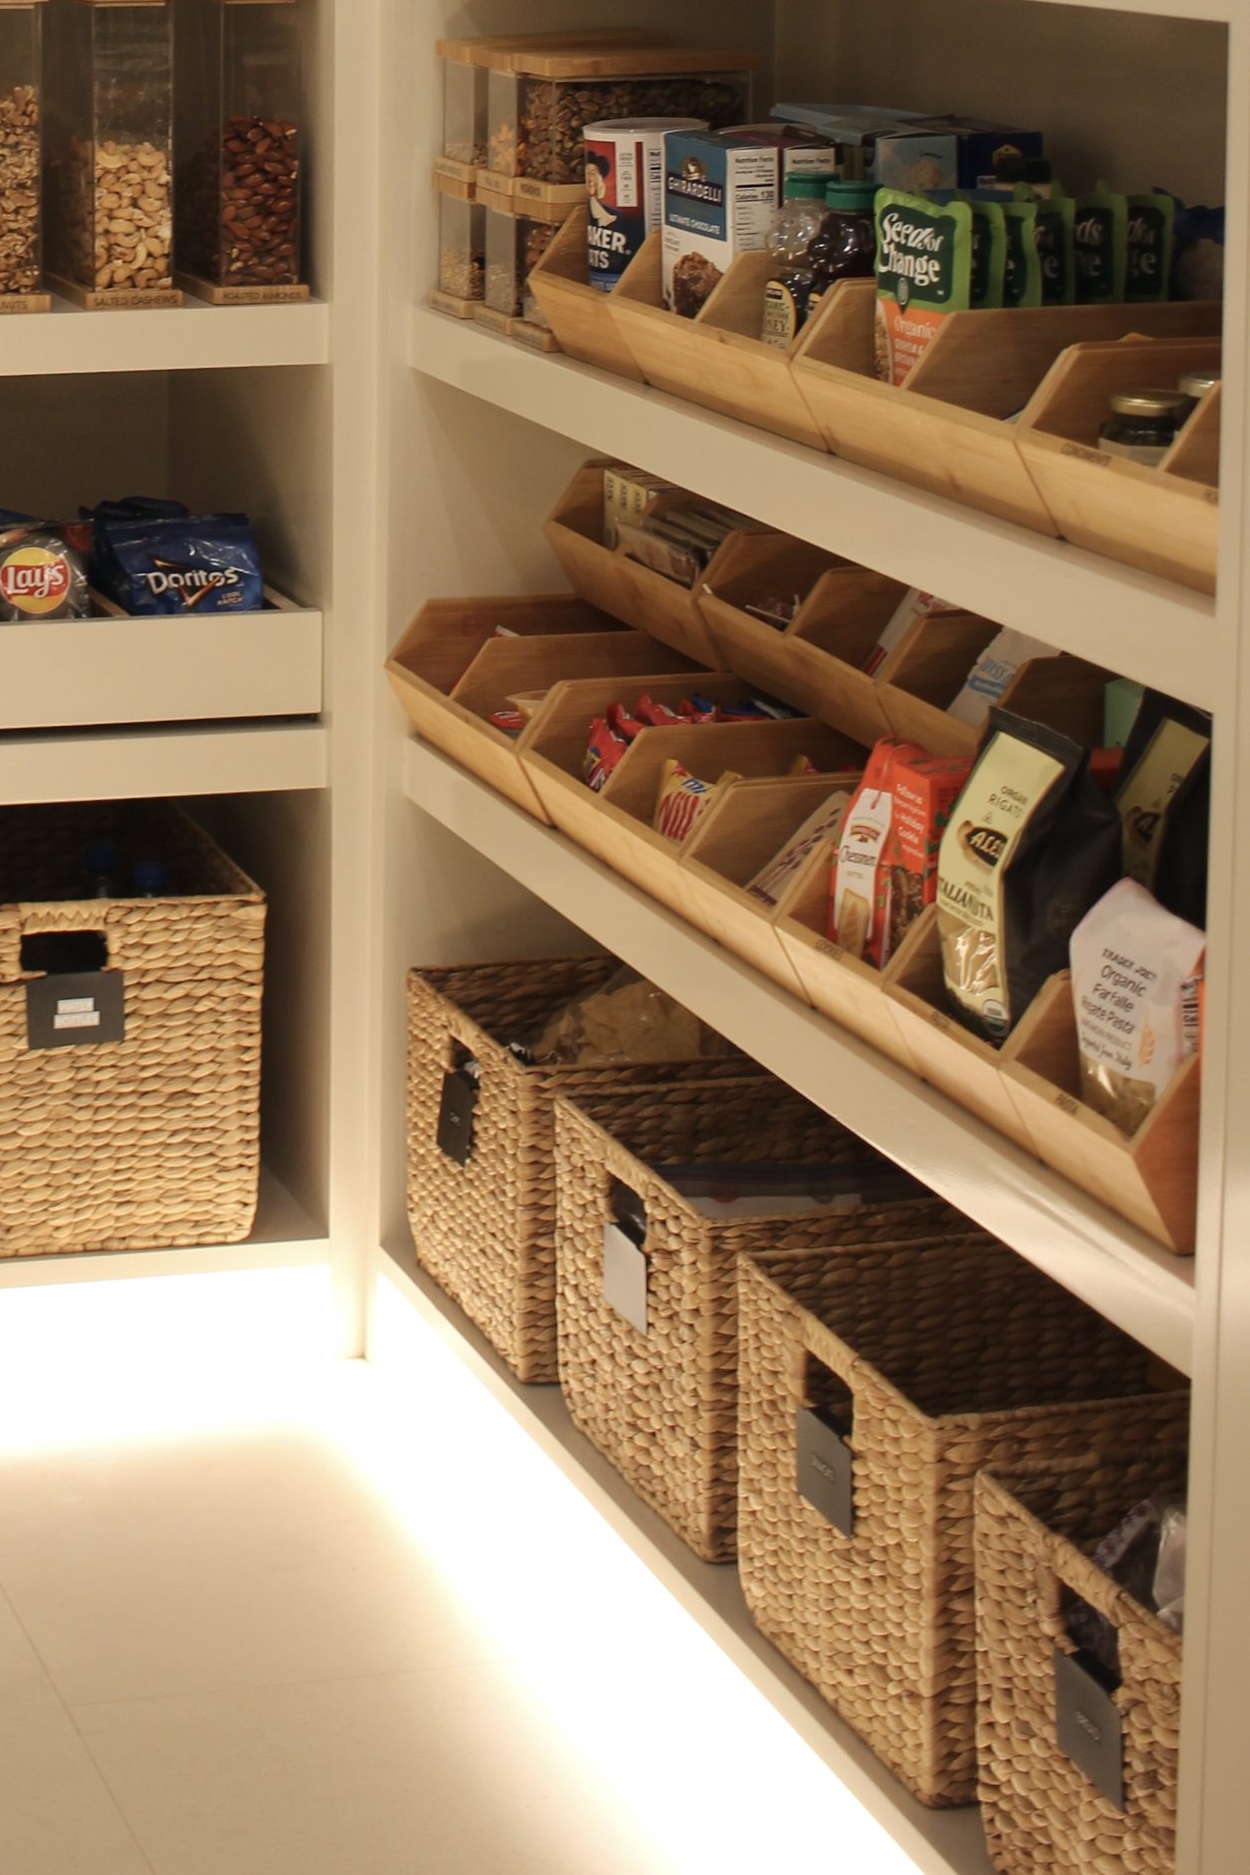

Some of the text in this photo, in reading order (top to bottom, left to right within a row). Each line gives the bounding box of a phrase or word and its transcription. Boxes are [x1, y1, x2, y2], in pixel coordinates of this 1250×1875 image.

[668, 176, 722, 203] GHIRARDELLI
[882, 212, 945, 252] Seeds of
[879, 240, 941, 286] Change
[94, 295, 178, 307] SALTED CASHEWS
[222, 291, 303, 301] ROASTED ALMONDS
[6, 564, 65, 597] Lay's
[146, 569, 239, 595] Doritos
[1101, 964, 1147, 997] Organic
[1092, 983, 1134, 1013] Farfalle
[1107, 1010, 1135, 1035] Pasta
